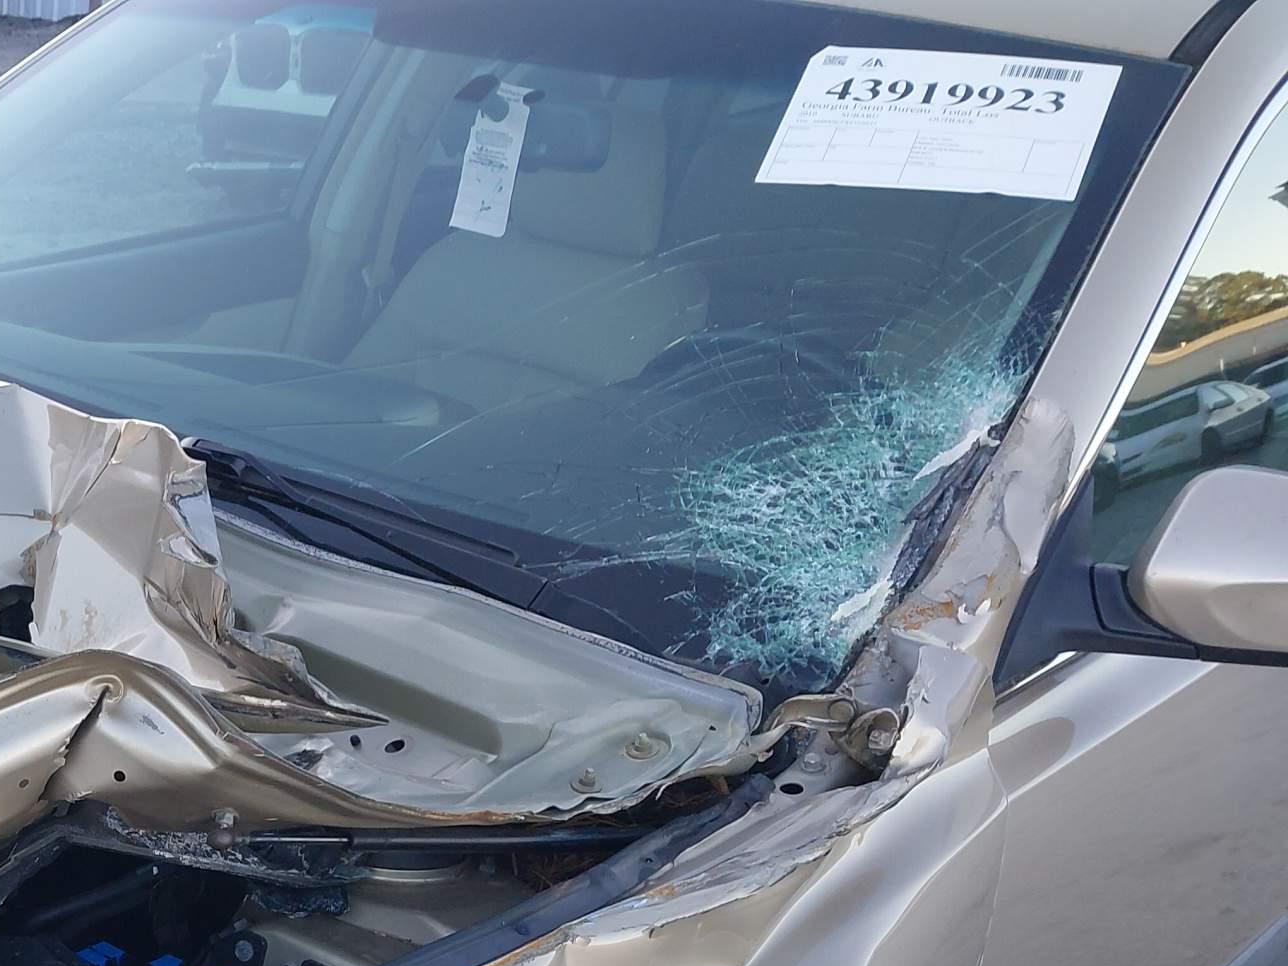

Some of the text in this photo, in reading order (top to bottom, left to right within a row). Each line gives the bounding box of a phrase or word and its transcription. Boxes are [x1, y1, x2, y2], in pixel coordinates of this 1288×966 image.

[825, 77, 1067, 114] 43919923
[801, 102, 850, 112] Georgia
[852, 103, 884, 112] Farm
[888, 104, 931, 114] Bureau
